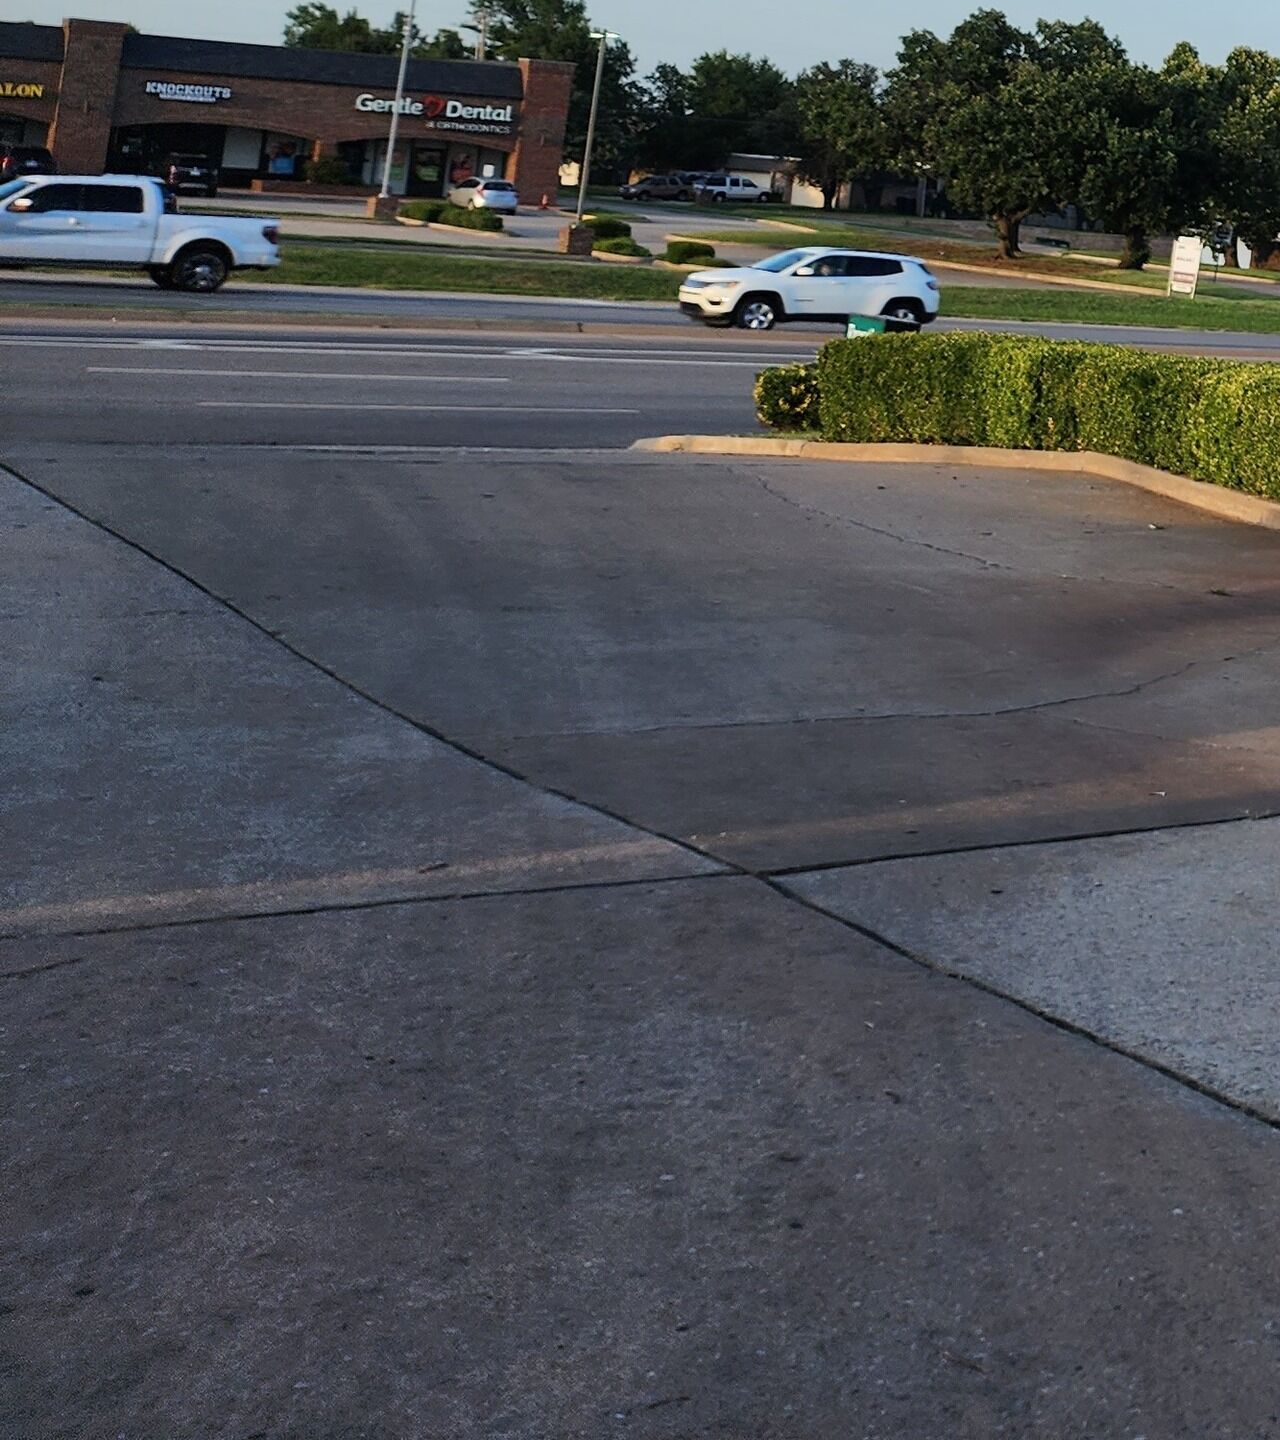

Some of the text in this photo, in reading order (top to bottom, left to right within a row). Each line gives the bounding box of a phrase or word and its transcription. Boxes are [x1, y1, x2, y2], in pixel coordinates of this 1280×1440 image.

[0, 82, 44, 98] LON
[145, 81, 232, 99] KNOCKOUTS
[445, 101, 514, 122] Dental
